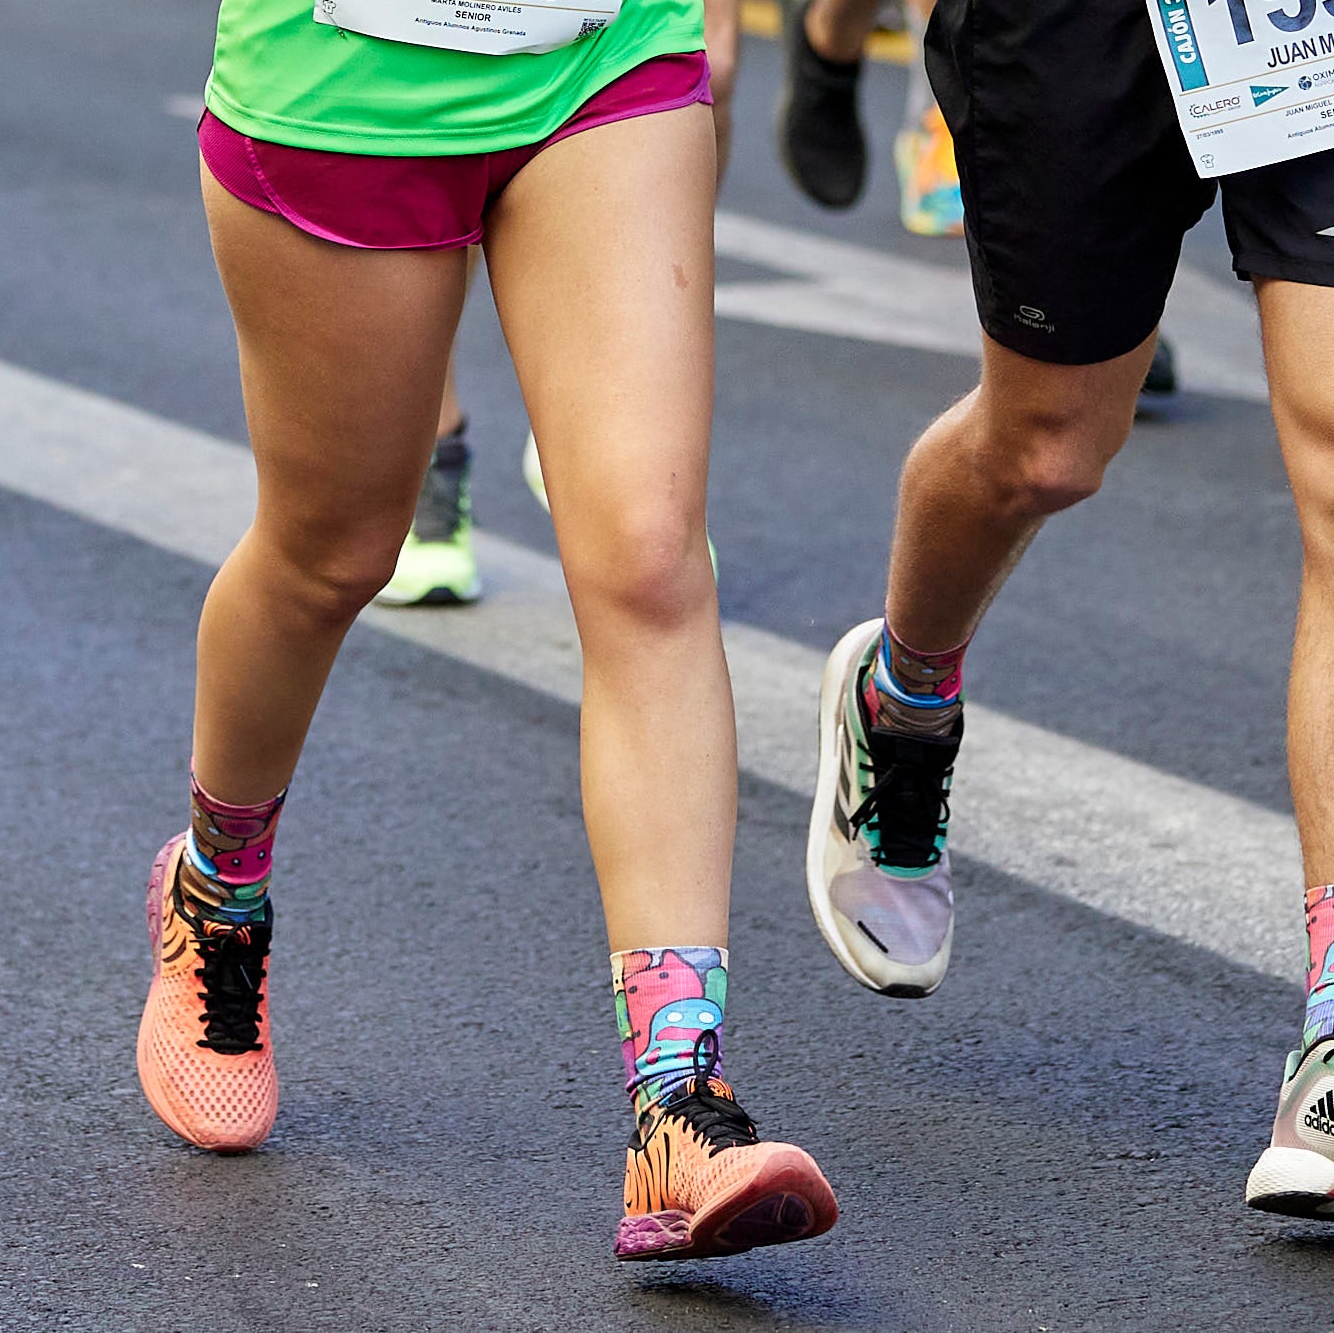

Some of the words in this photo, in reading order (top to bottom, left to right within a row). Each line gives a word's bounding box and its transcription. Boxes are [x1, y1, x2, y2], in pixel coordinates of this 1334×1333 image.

[458, 0, 496, 11] MOLINERO
[455, 10, 492, 22] SENIOR
[415, 17, 442, 27] Antiguos
[443, 21, 469, 30] Alumnos
[471, 25, 501, 34] Agustinos
[502, 29, 526, 37] Granada
[1167, 8, 1197, 64] CAJÓN
[1267, 37, 1318, 68] JUAN
[1192, 96, 1241, 115] CALERO
[1285, 106, 1304, 117] JUAN
[1305, 99, 1333, 111] MIGUEL
[1287, 128, 1314, 139] Antiguos
